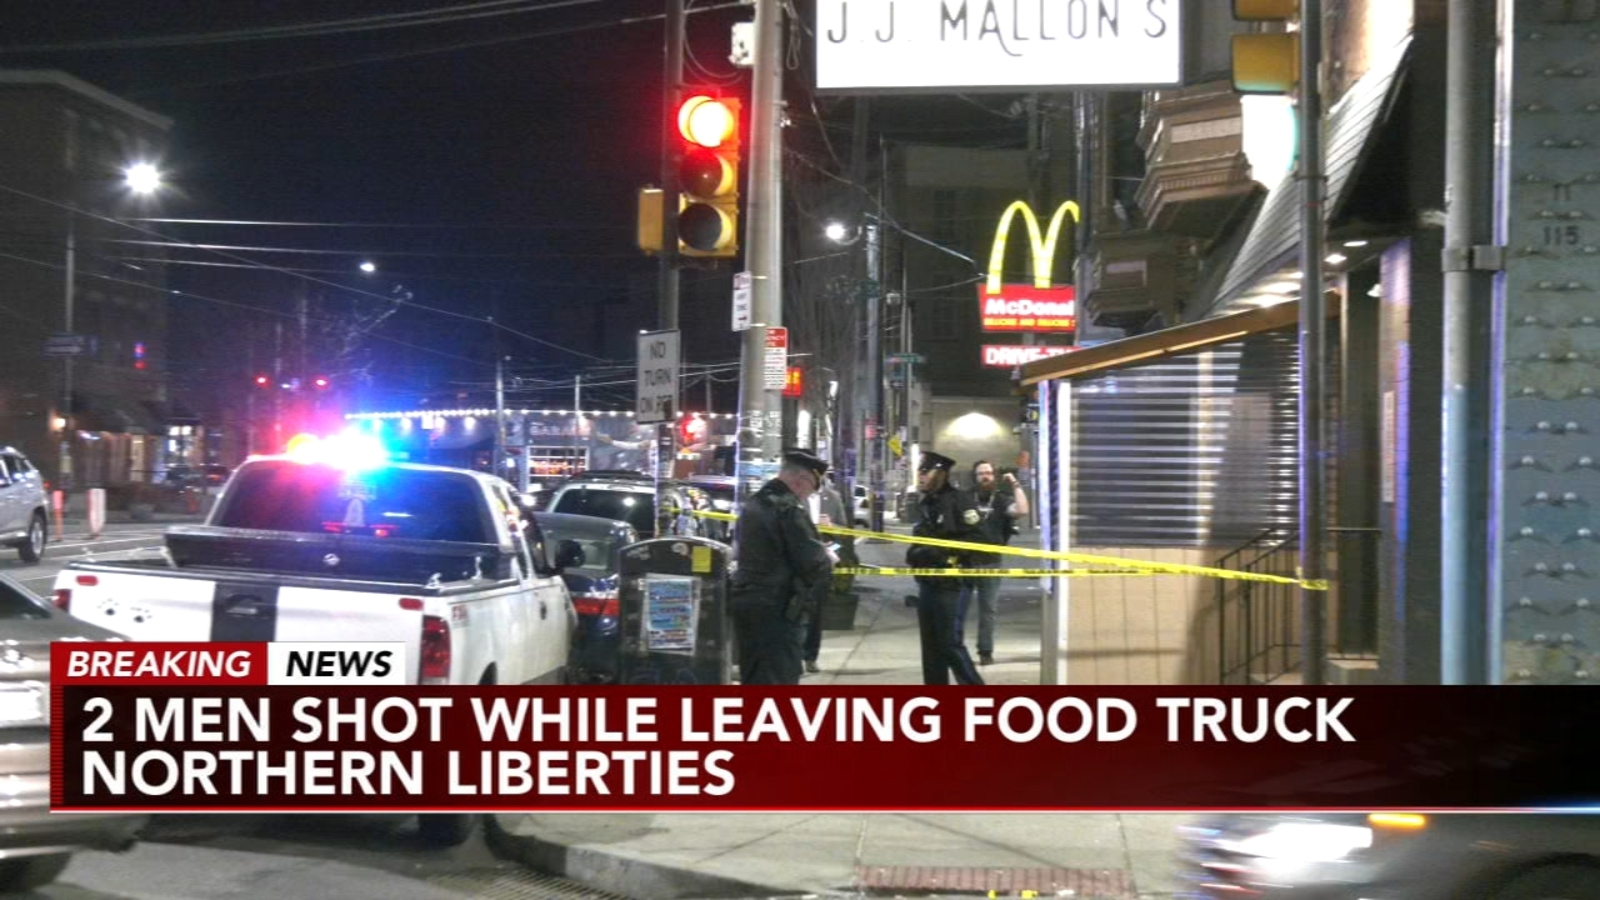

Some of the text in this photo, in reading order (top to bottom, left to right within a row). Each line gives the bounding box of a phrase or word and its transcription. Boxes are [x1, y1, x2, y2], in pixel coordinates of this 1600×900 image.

[1544, 225, 1580, 246] 115
[985, 298, 1075, 316] McDonal
[650, 341, 666, 359] NO
[645, 369, 672, 387] TURN
